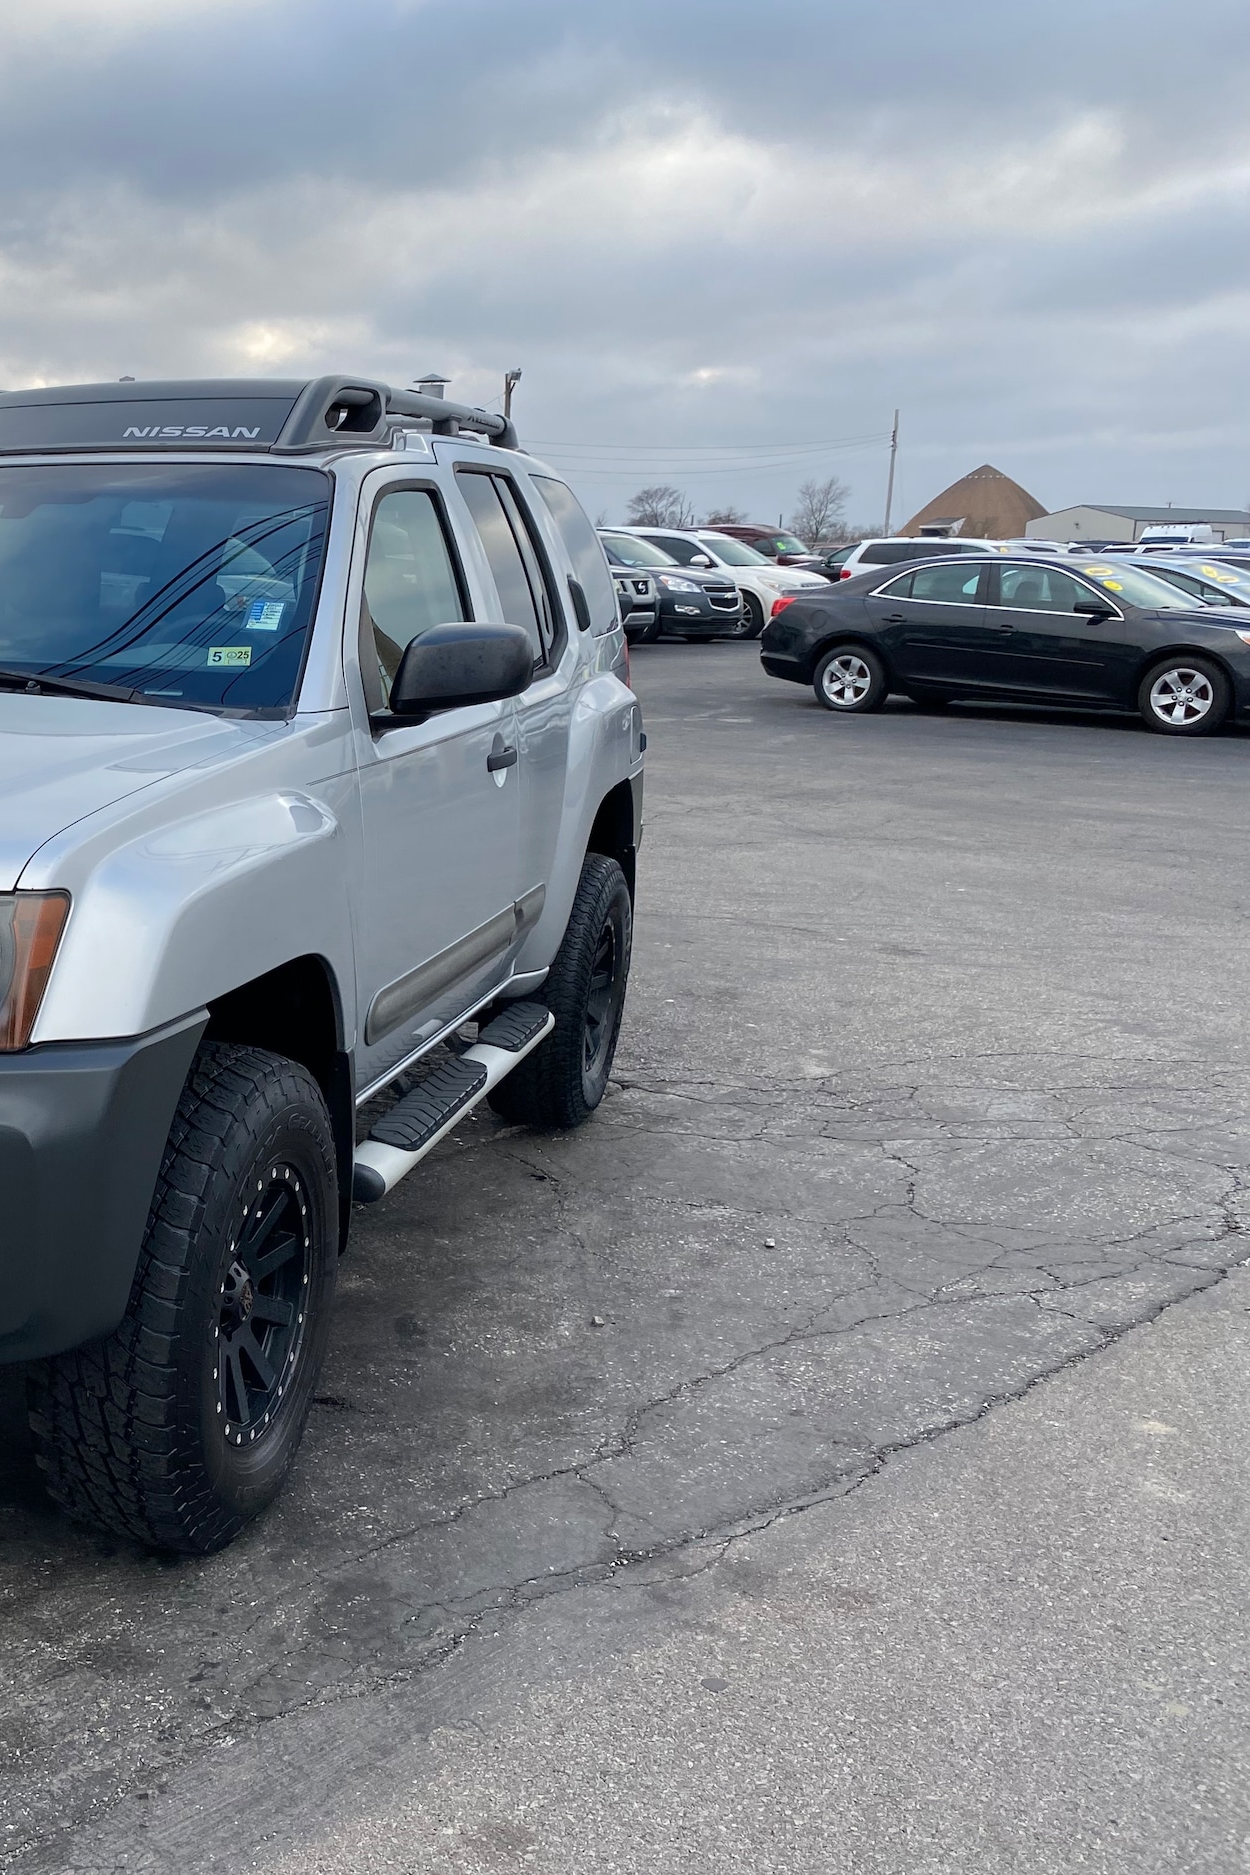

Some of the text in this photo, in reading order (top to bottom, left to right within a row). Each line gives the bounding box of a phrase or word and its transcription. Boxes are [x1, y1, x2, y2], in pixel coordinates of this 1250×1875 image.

[122, 426, 261, 438] NISSAN
[212, 650, 250, 663] 5 25
